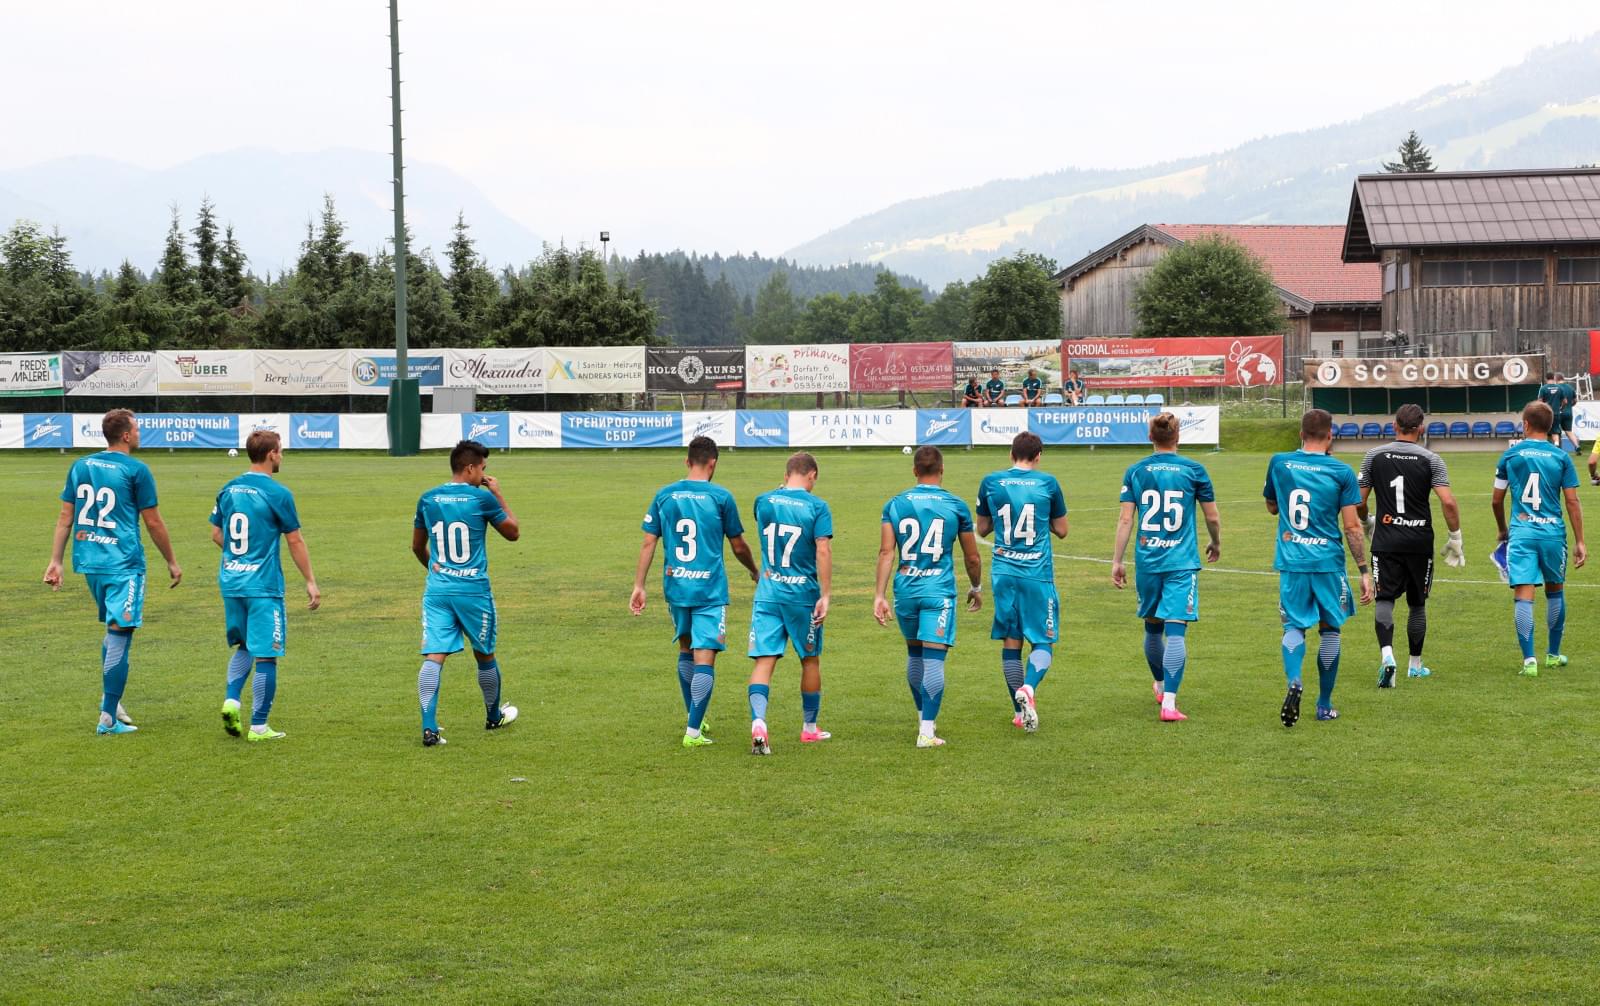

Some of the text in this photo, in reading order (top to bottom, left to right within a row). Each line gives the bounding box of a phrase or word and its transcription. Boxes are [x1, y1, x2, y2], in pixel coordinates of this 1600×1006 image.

[1068, 343, 1110, 355] CORDIAL
[11, 370, 50, 382] MALEREI
[449, 354, 541, 379] Alexandra
[648, 366, 677, 374] HOLZ
[705, 365, 744, 374] KUNST
[1354, 362, 1491, 381] SC GOING
[135, 416, 230, 430] РЕНИРОВОЧНЫЙ
[568, 414, 673, 428] ТРЕНИРОВОЧНЫЙ
[810, 415, 893, 426] TRAINING
[1036, 410, 1150, 424] ТРЕНИРОВОЧНЫЙ
[166, 431, 195, 442] СБОР
[605, 430, 636, 441] СБОР
[829, 429, 874, 440] CAMP
[1076, 426, 1110, 438] СБОР
[1389, 475, 1405, 514] 1
[1521, 472, 1542, 511] 4
[77, 483, 117, 529] 22
[1141, 489, 1184, 532] 25
[1288, 488, 1311, 531] 6
[229, 512, 249, 555] 9
[997, 503, 1036, 546] 14
[431, 521, 471, 564] 10
[675, 518, 697, 562] 3
[763, 522, 803, 568] 17
[898, 517, 945, 563] 24
